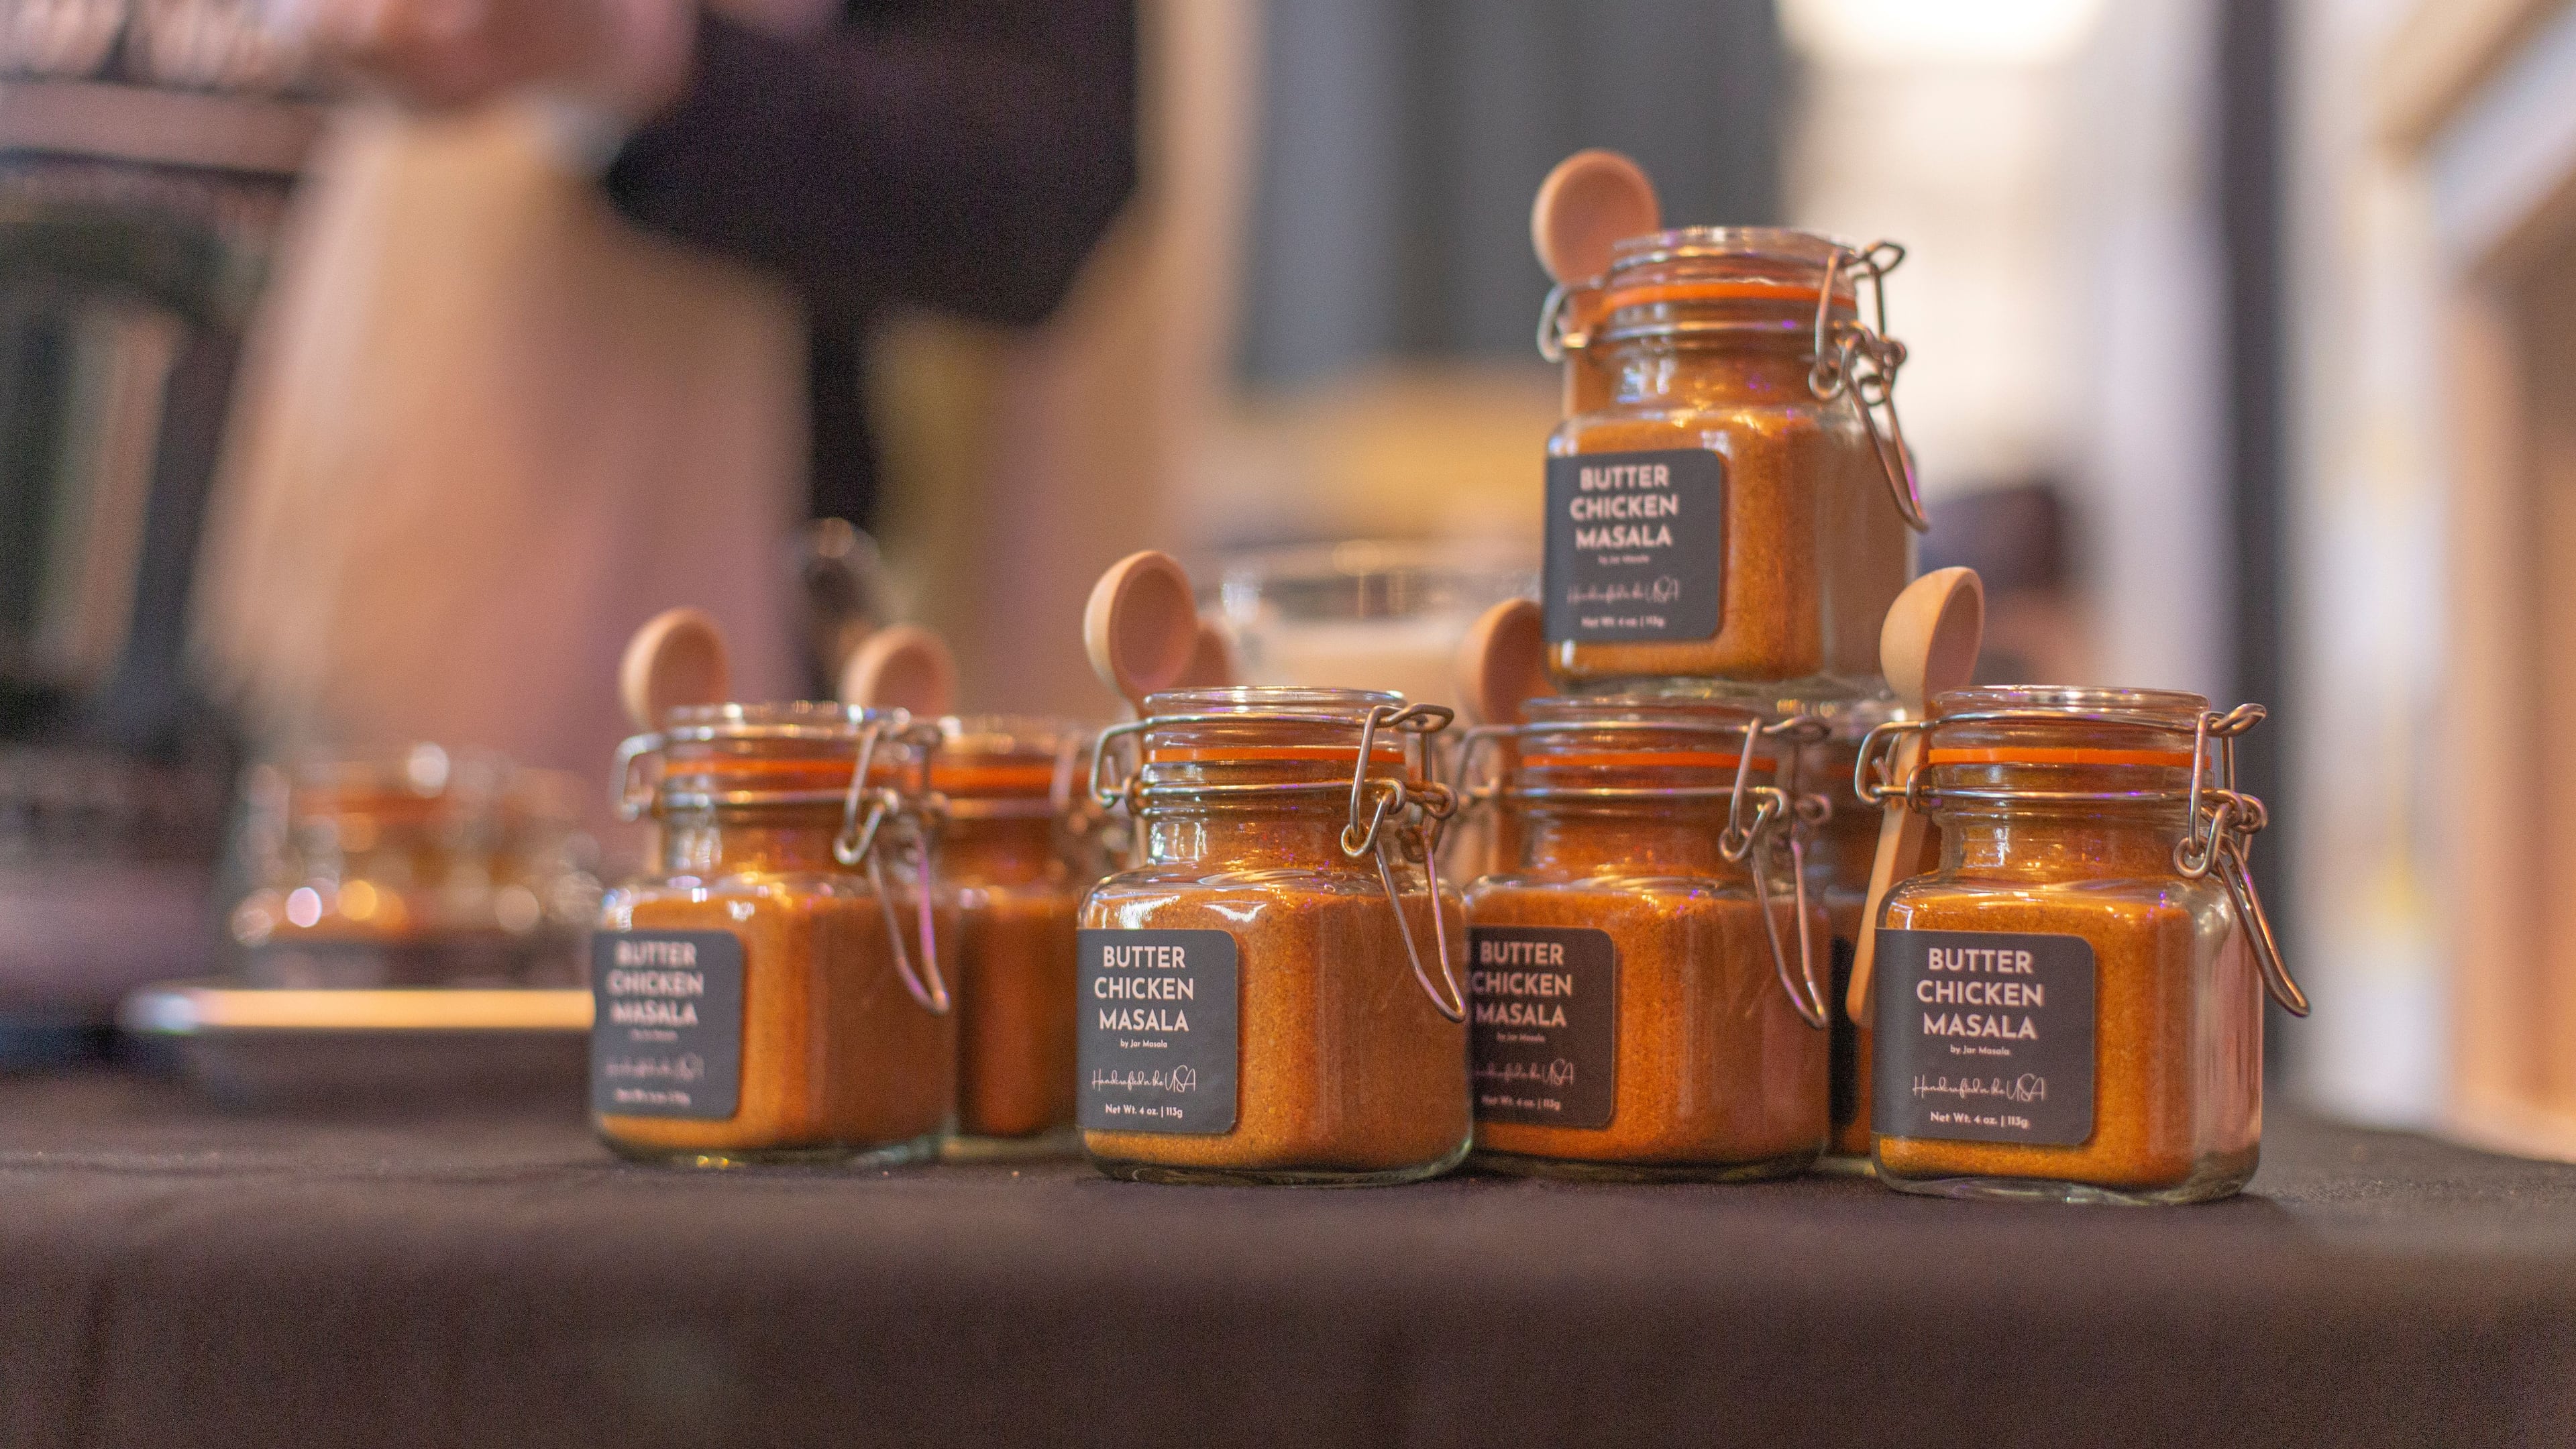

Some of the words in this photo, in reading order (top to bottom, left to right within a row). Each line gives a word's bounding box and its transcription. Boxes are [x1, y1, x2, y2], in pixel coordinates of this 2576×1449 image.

[1580, 464, 1670, 491] BUTTER
[1570, 494, 1678, 521] CHICKEN
[1576, 525, 1672, 549] MASALA
[615, 940, 696, 967] BUTTER
[1104, 946, 1185, 968] BUTTER
[1480, 941, 1564, 966] BUTTER
[1929, 948, 2033, 973] BUTTER
[606, 970, 704, 998] CHICKEN
[1094, 977, 1193, 1000] CHICKEN
[1471, 972, 1572, 996] CHICKEN
[1917, 979, 2043, 1008] CHICKEN
[610, 1000, 698, 1026] MASALA
[1099, 1008, 1189, 1032] MASALA
[1477, 1003, 1567, 1028] MASALA
[1923, 1012, 2037, 1039] MASALA
[1120, 1038, 1128, 1049] by
[1130, 1039, 1140, 1048] Jar
[1142, 1039, 1167, 1049] Masala
[1950, 1044, 1960, 1055] by
[1964, 1045, 1976, 1055] Jar
[1979, 1046, 2010, 1056] Masala
[1092, 1068, 1144, 1091] Handcrafted
[1152, 1069, 1164, 1086] the
[1165, 1065, 1196, 1093] USA
[1912, 1074, 1979, 1099] Handcrafted
[2006, 1073, 2045, 1102] USA
[1106, 1104, 1120, 1114] Net
[1123, 1104, 1137, 1115] Wt.
[1139, 1107, 1144, 1115] 4
[1146, 1107, 1159, 1115] oz.
[1167, 1107, 1183, 1119] 113g
[1930, 1111, 1949, 1122] Net
[1953, 1112, 1971, 1123] Wt.
[1974, 1114, 1980, 1124] 4
[1983, 1116, 1997, 1124] oz.
[2008, 1116, 2029, 1129] 113g
